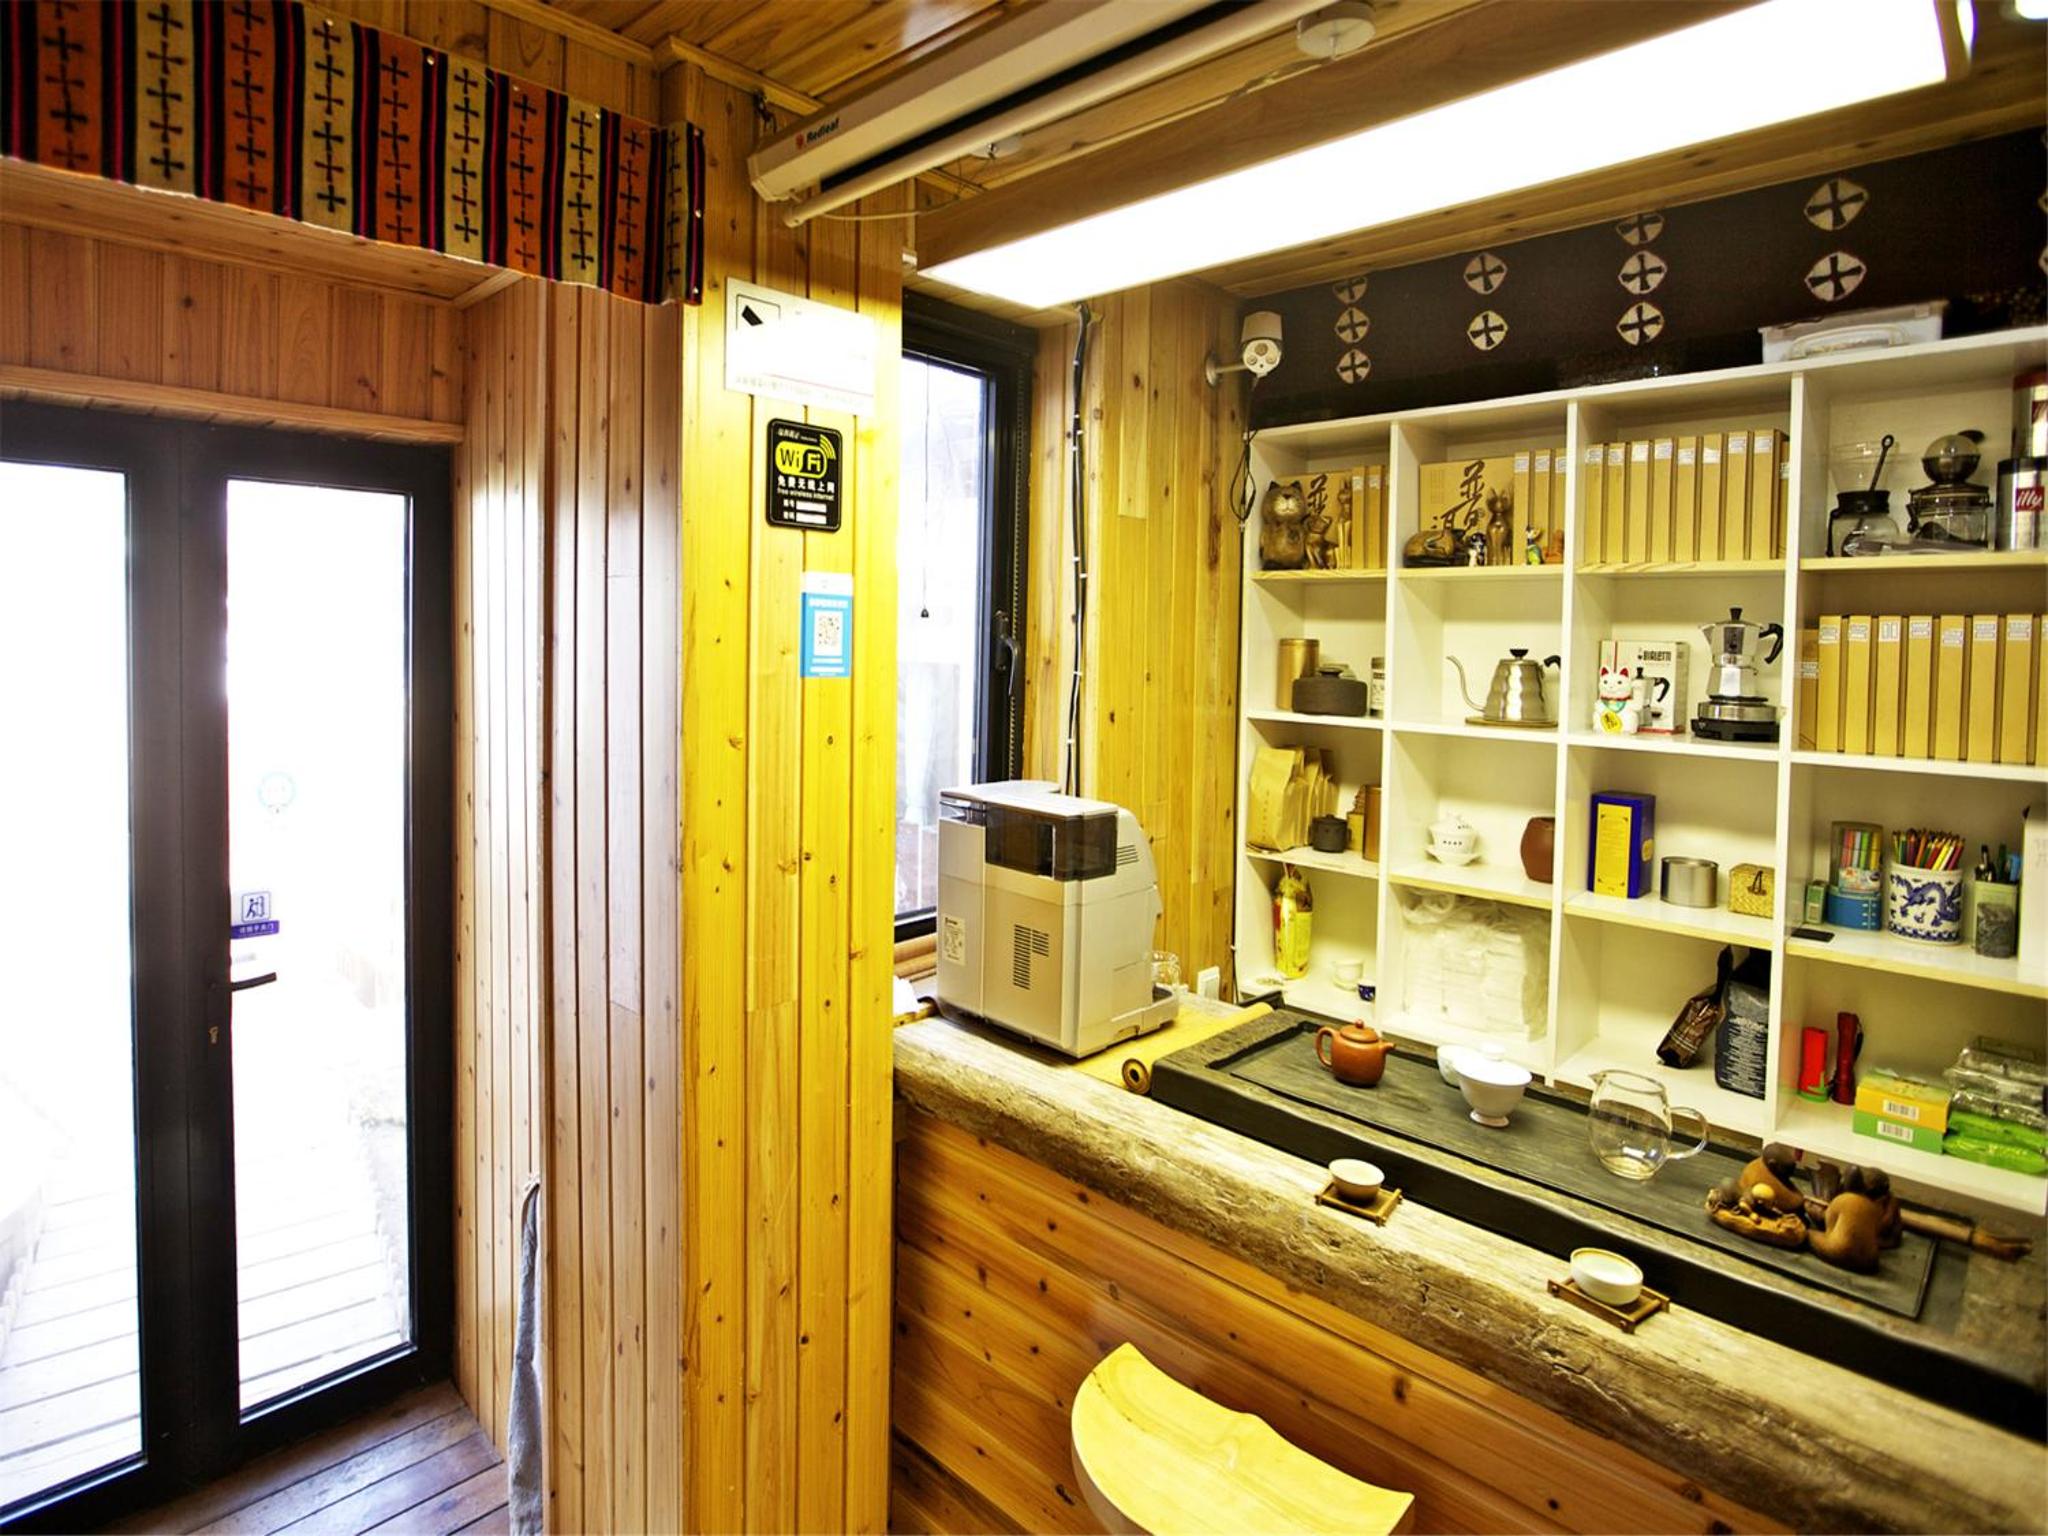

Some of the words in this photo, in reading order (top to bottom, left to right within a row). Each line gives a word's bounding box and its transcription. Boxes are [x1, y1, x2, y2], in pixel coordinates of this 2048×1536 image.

[777, 475, 835, 494] 免费无线上网
[2017, 490, 2042, 510] illy
